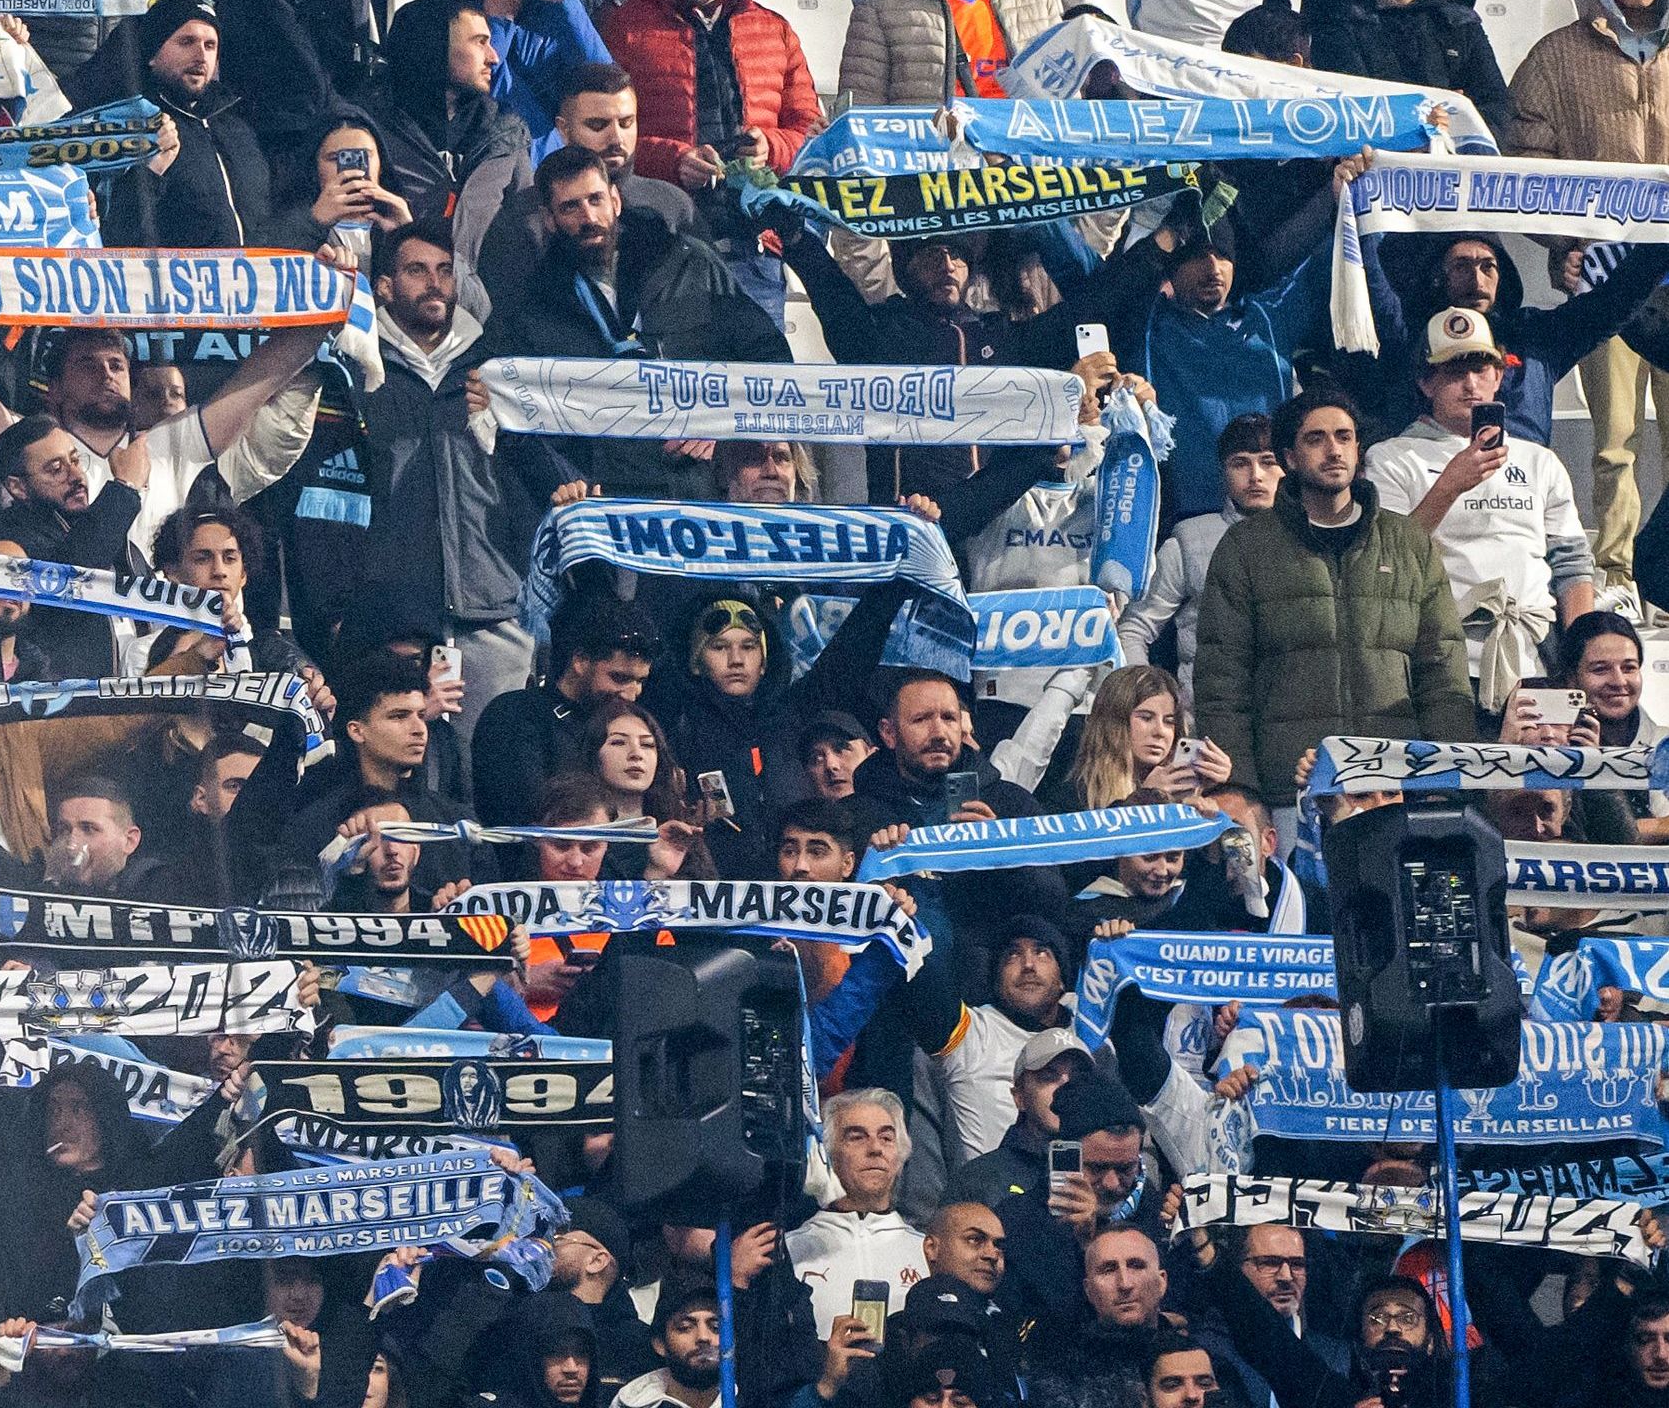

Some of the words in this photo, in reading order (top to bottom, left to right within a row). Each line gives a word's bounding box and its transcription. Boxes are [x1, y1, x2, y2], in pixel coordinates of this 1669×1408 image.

[1007, 100, 1213, 145] ALLEZ
[1237, 95, 1396, 145] L'OM
[27, 137, 152, 166] 2009
[1361, 169, 1458, 210] PIQUE
[850, 213, 943, 236] SOMMES
[950, 208, 997, 227] LES
[1004, 188, 1145, 221] MARSEILLAIS
[15, 256, 129, 315] NOUS
[143, 256, 259, 317] C'EST
[1463, 494, 1534, 512] randstad
[985, 608, 1109, 649] DROI
[1507, 861, 1669, 894] ARSEI
[275, 912, 452, 947] 1994
[1158, 943, 1231, 963] QUAND
[1234, 944, 1255, 963] LE
[1262, 944, 1334, 964] VIRAGE
[1134, 966, 1186, 988] C'EST
[1191, 967, 1242, 988] TOUT
[1247, 969, 1267, 989] LE
[1271, 969, 1334, 990] STADE
[1325, 1115, 1389, 1133] FIERS
[1482, 1114, 1633, 1135] MARSEILLAIS
[321, 1157, 476, 1184] MARSEILLAIS
[123, 1196, 253, 1237] ALLEZ
[265, 1171, 506, 1230] MARSEILLE
[292, 1214, 483, 1254] MARSEILLAIS
